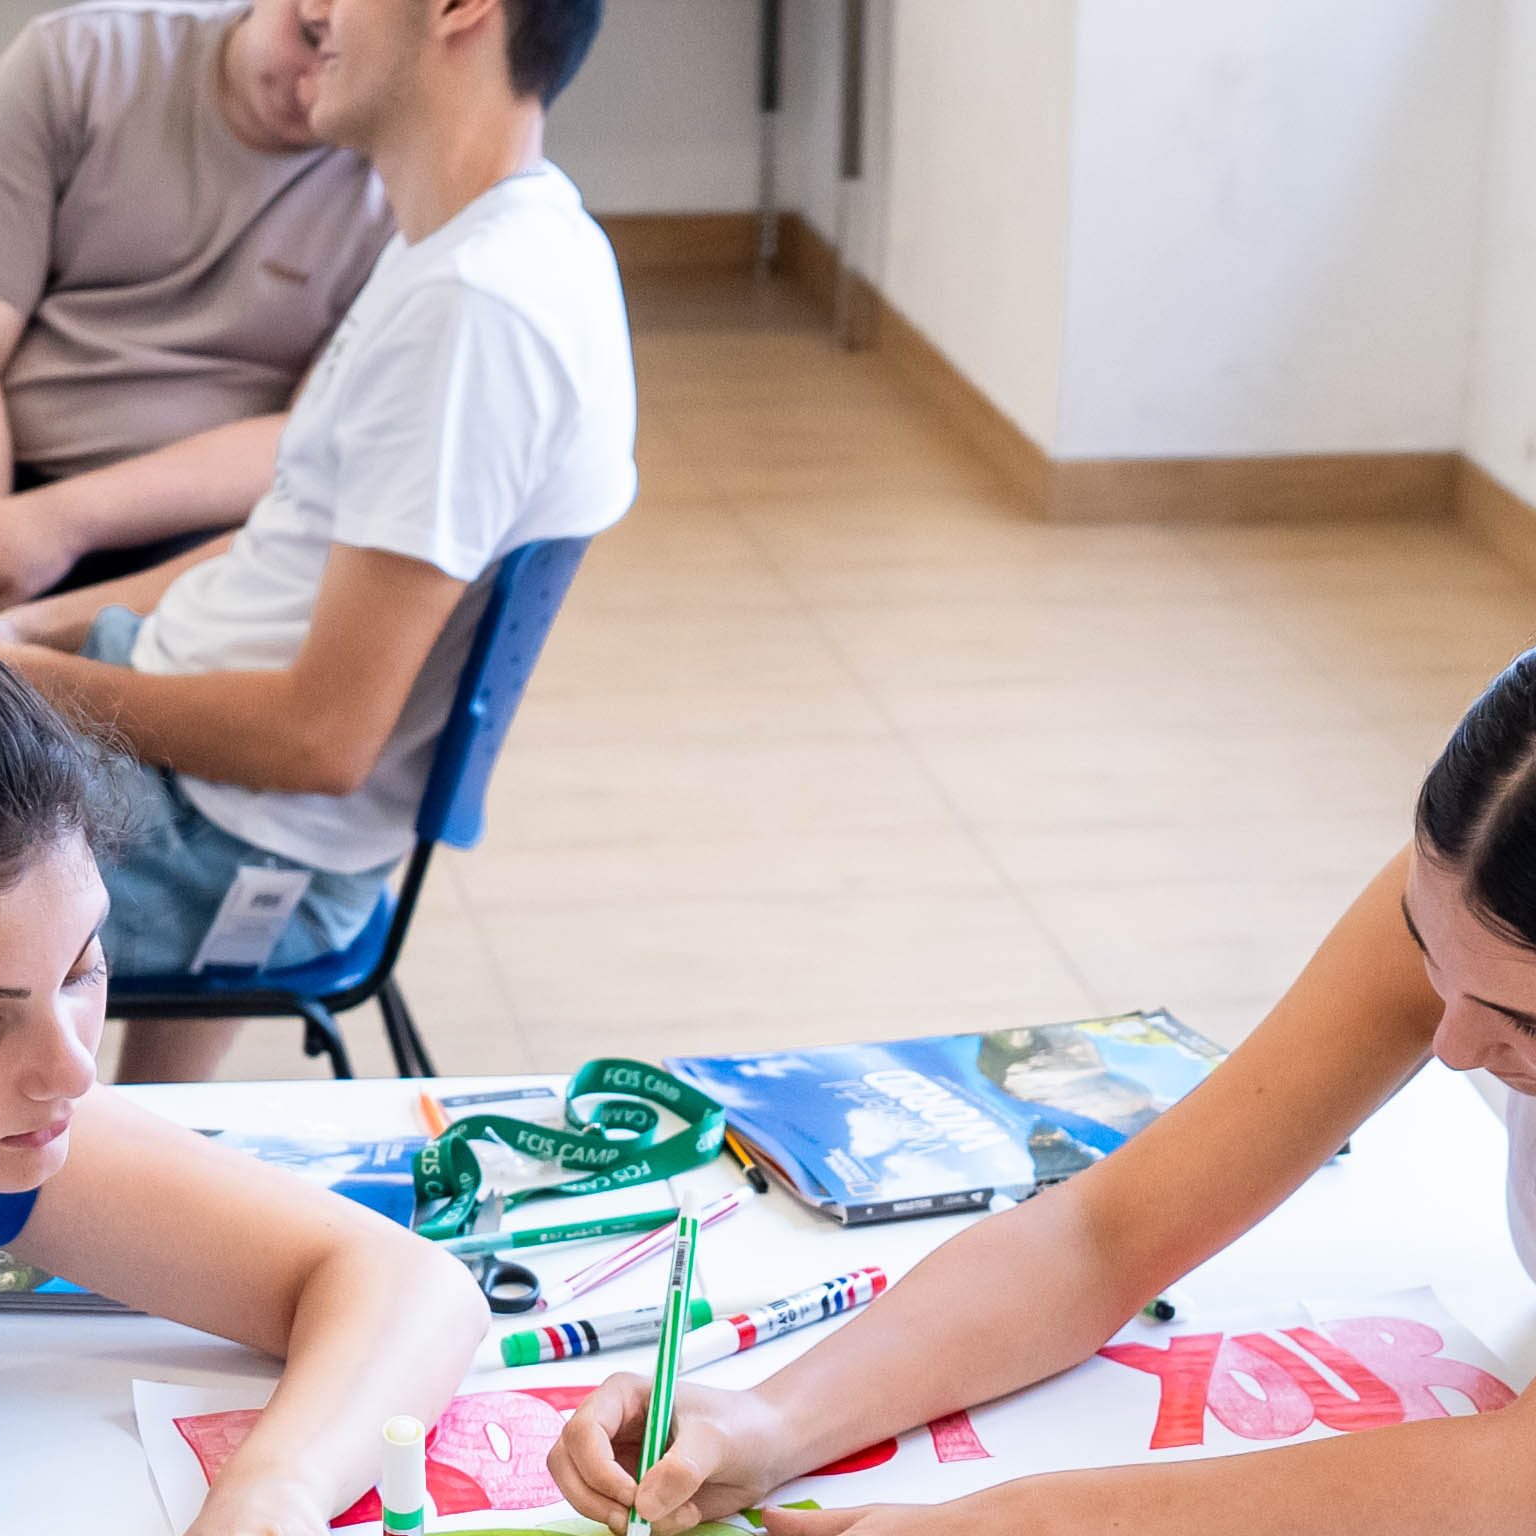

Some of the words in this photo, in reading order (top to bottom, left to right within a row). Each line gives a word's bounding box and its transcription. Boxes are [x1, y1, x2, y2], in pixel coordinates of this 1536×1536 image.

[602, 1067, 641, 1087] FCIS
[644, 1075, 681, 1101] CAMP
[516, 1129, 559, 1160] FCIS
[558, 1143, 620, 1164] CAMP
[611, 1160, 652, 1183] FCIS
[1096, 1317, 1520, 1450] YOUR
